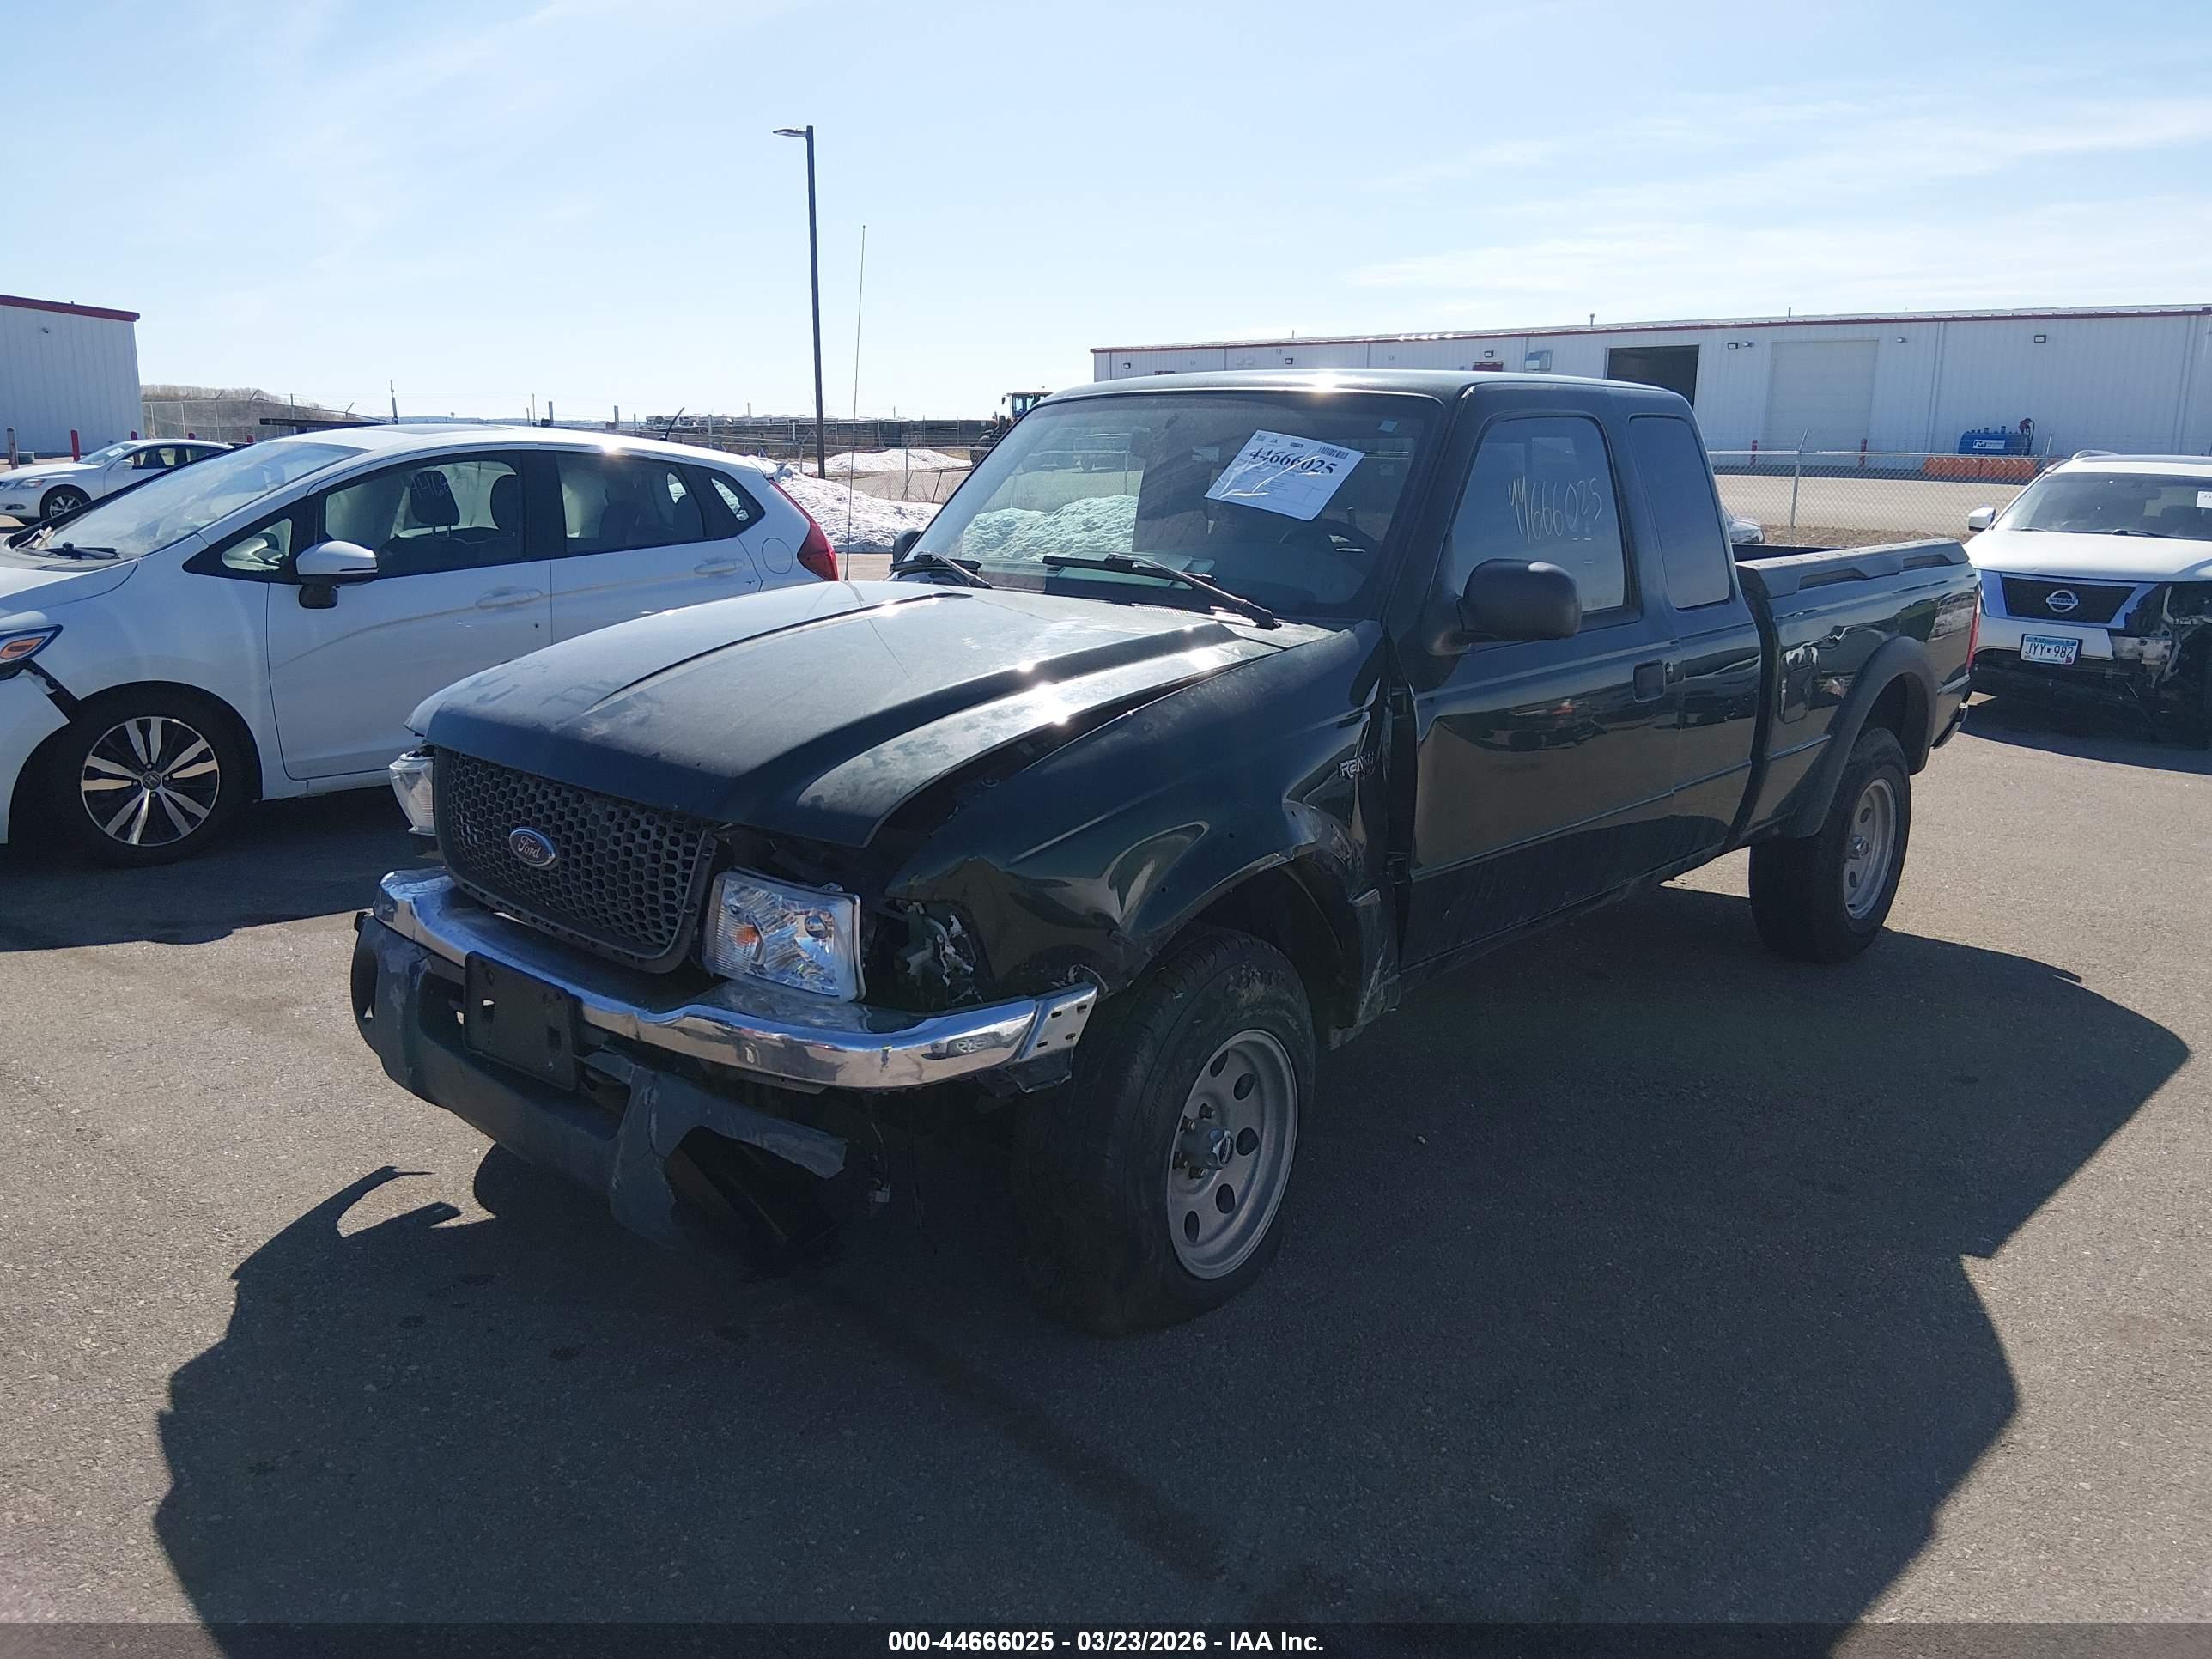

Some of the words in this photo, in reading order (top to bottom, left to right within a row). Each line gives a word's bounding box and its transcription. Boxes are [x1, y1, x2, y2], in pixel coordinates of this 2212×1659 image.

[1249, 447, 1339, 474] 44666025
[2025, 642, 2046, 656] JYY
[2054, 646, 2074, 659] 982
[518, 836, 542, 858] Ford
